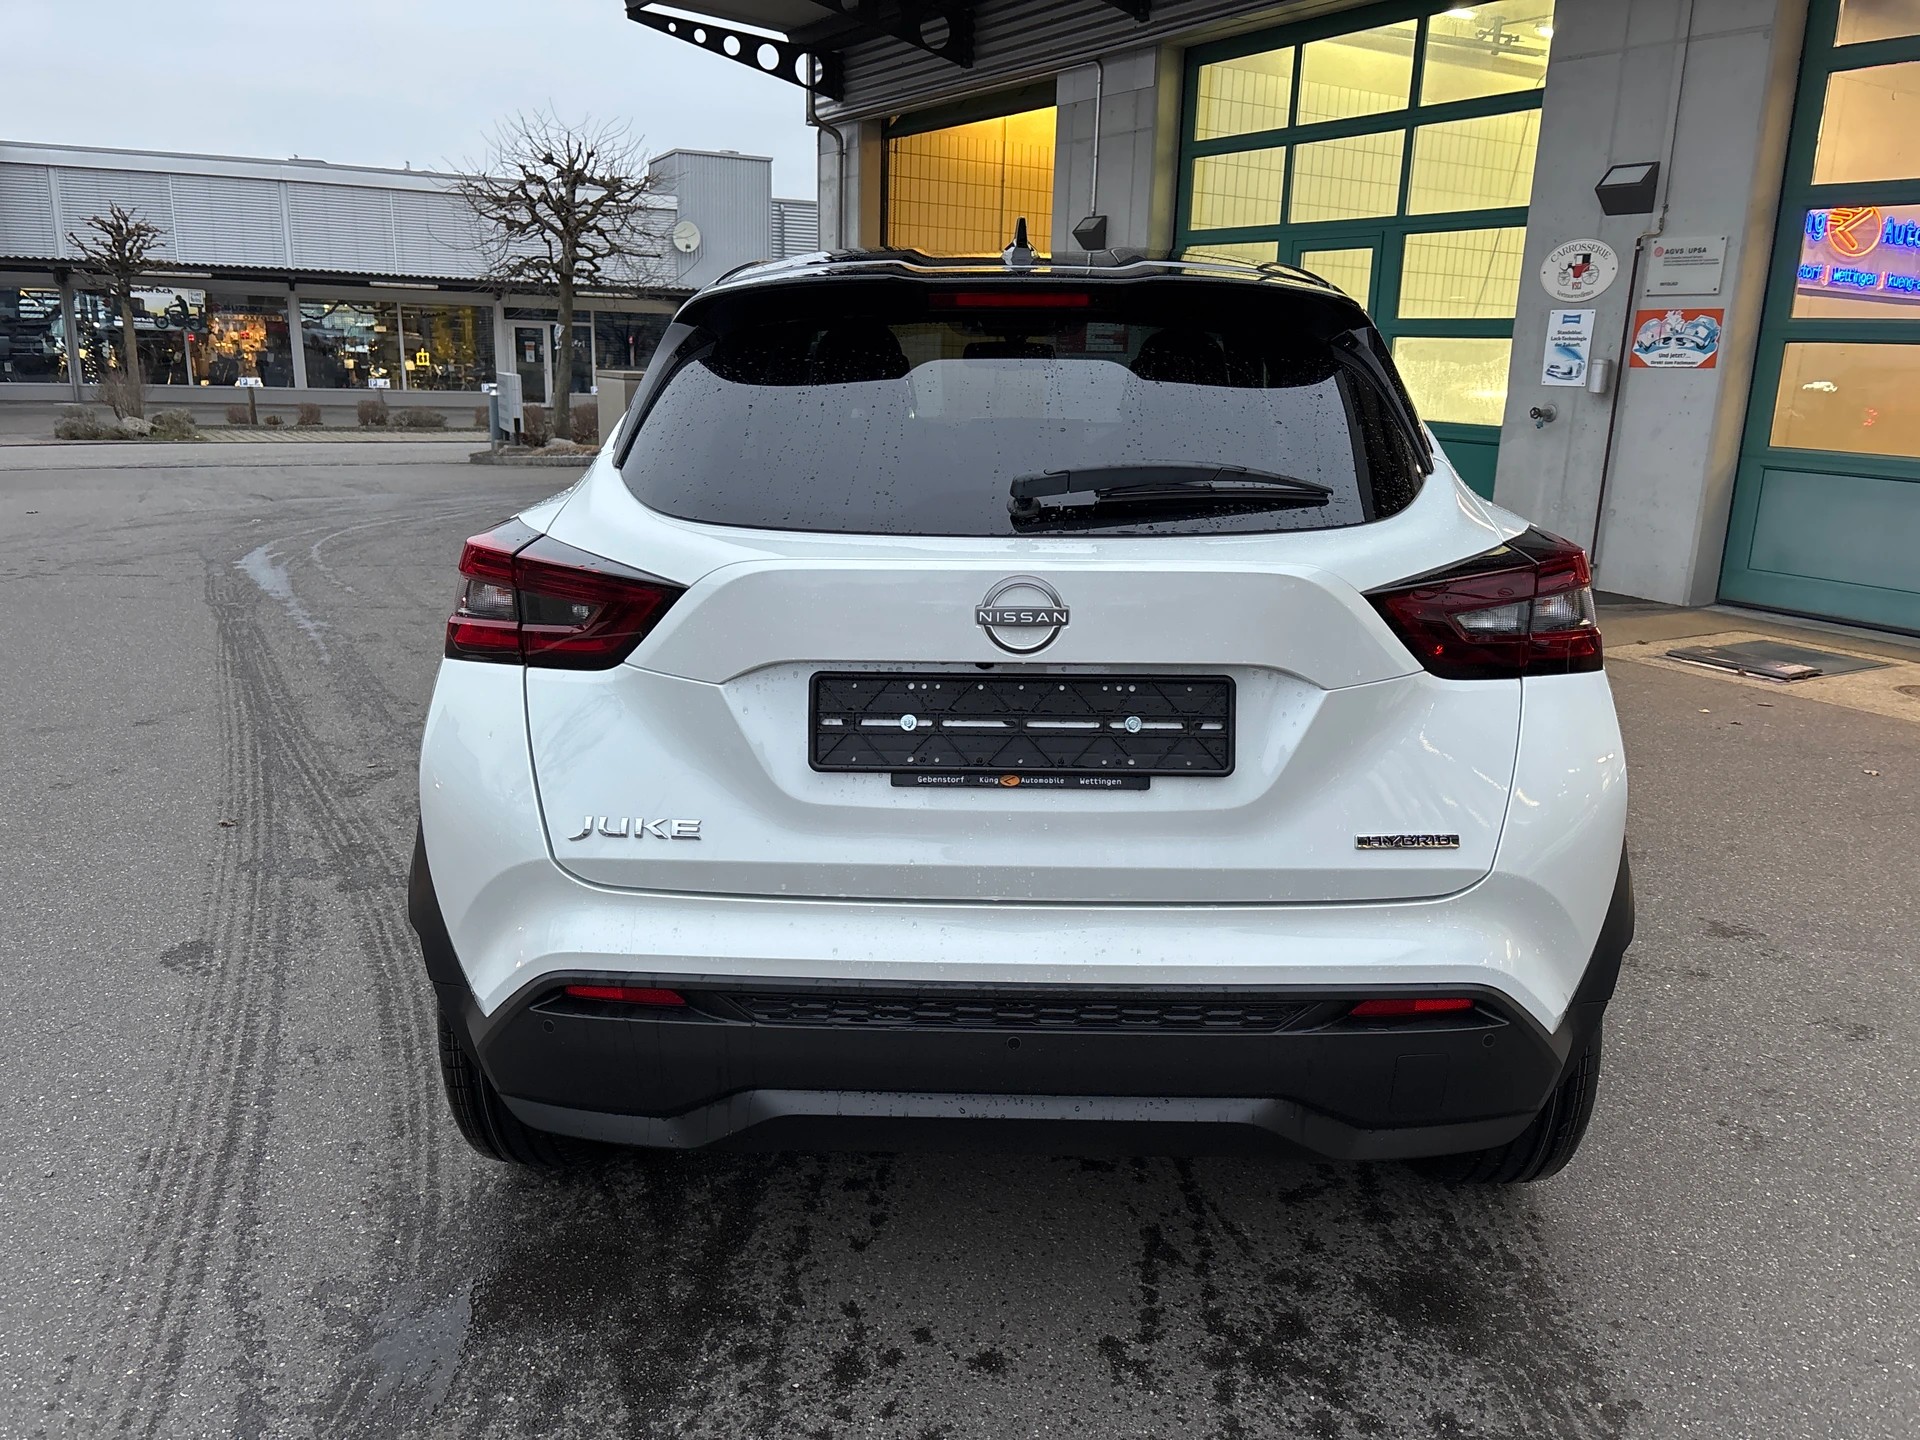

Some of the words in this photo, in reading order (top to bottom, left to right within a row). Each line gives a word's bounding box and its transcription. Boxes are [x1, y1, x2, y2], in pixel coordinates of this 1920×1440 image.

[1550, 243, 1611, 263] CARROSSERIE
[1832, 267, 1877, 288] Wettingen
[978, 610, 1068, 624] NISSAN
[917, 775, 965, 783] Gebenstorf
[979, 776, 999, 784] Küng
[1079, 777, 1122, 786] Wettingen
[568, 815, 702, 841] JUKE
[1365, 834, 1452, 848] HYBRID
